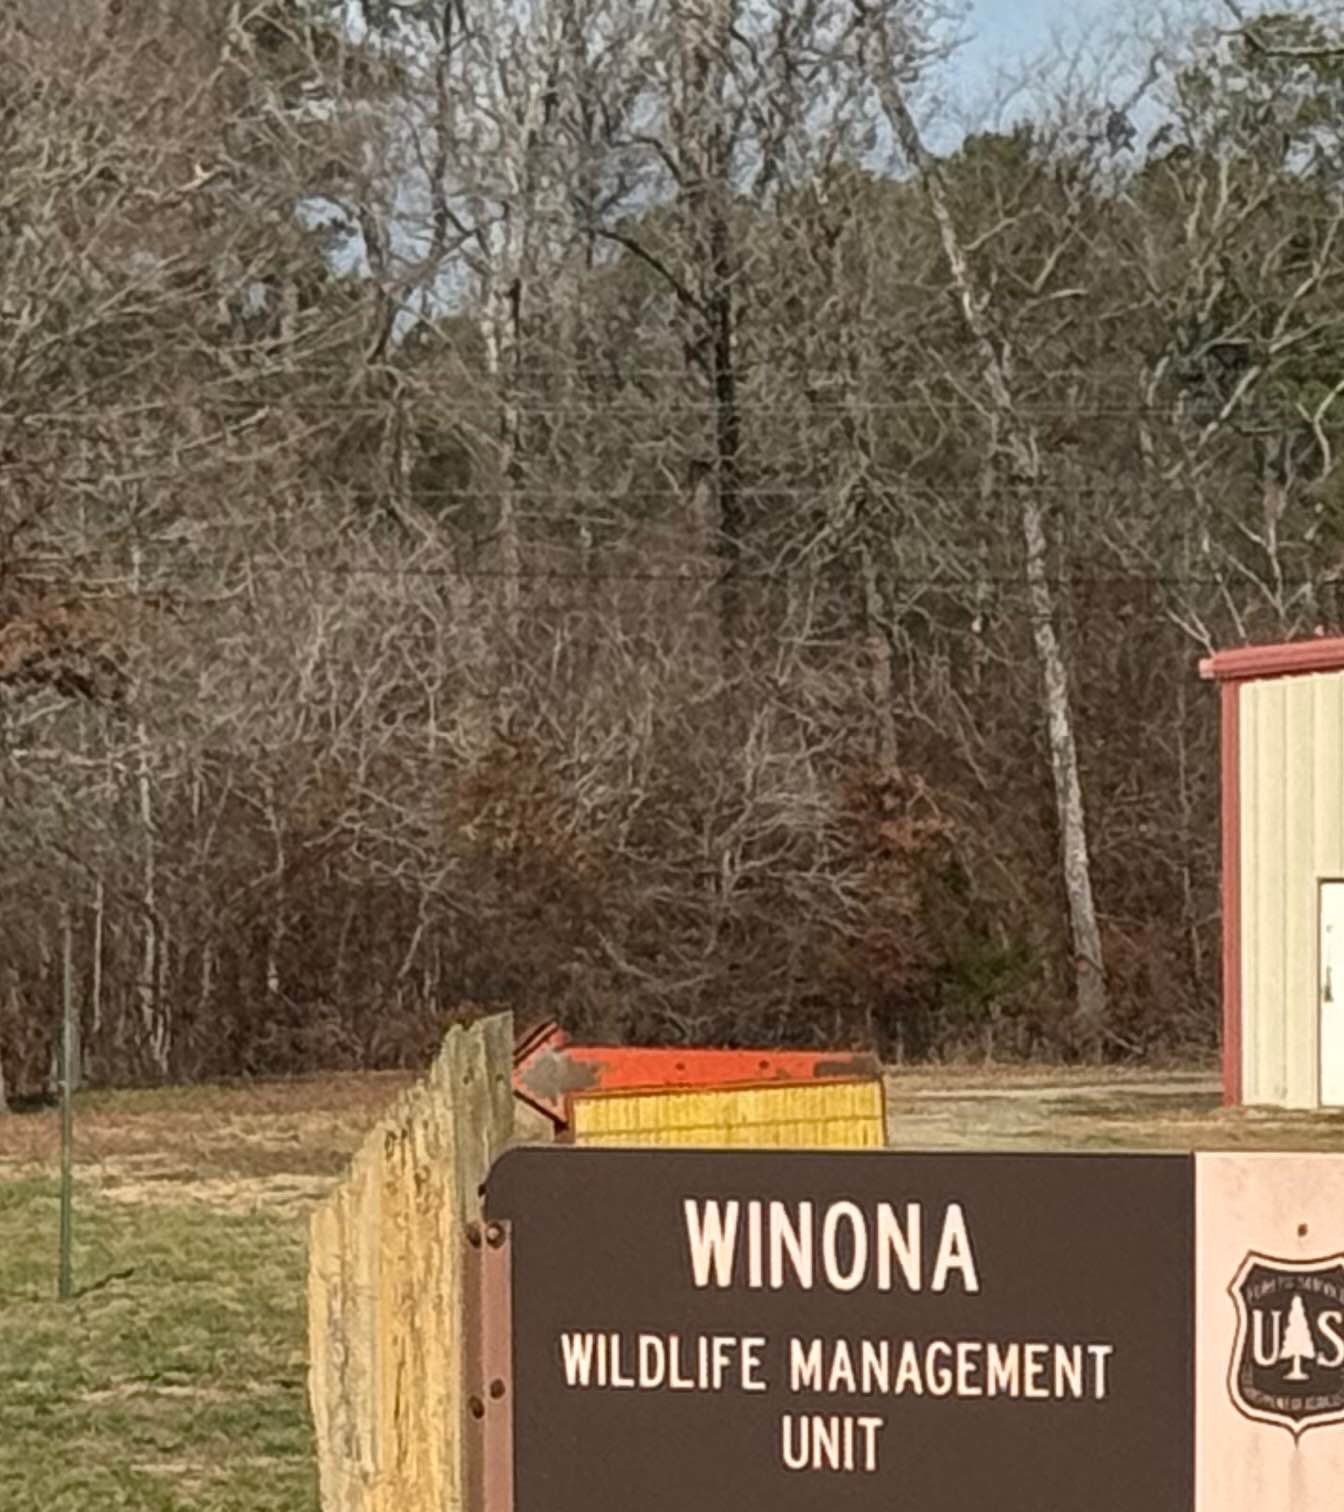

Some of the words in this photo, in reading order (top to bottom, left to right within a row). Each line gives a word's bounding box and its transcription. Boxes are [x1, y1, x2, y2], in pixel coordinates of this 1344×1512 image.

[683, 1198, 980, 1293] WINONA
[560, 1333, 766, 1391] WILDLIFE
[789, 1338, 1113, 1400] MANAGEMENT
[781, 1415, 884, 1471] UNIT
